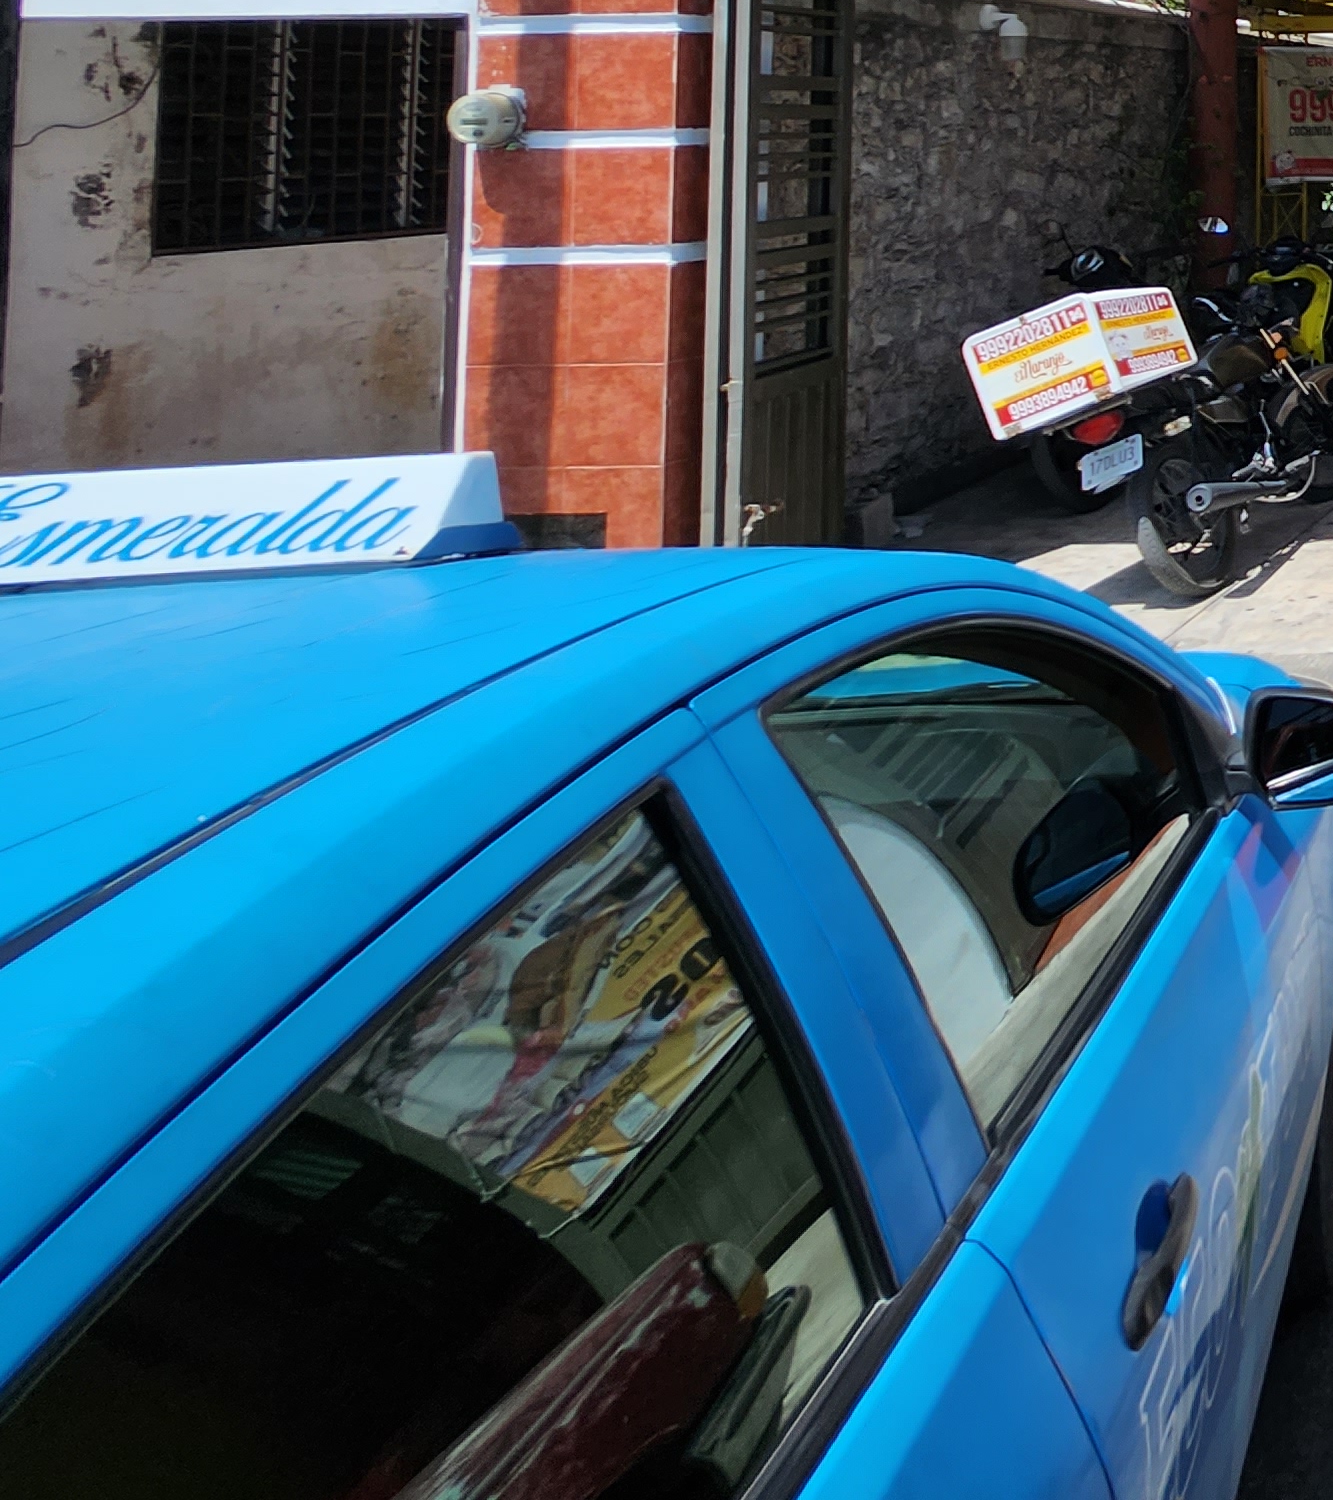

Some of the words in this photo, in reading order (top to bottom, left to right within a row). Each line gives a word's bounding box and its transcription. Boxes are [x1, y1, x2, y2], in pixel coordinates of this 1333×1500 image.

[978, 310, 1071, 360] 9992202811
[987, 349, 1029, 371] ERNESTO
[1020, 352, 1072, 378] Naranjo
[1008, 376, 1089, 421] 9993894942
